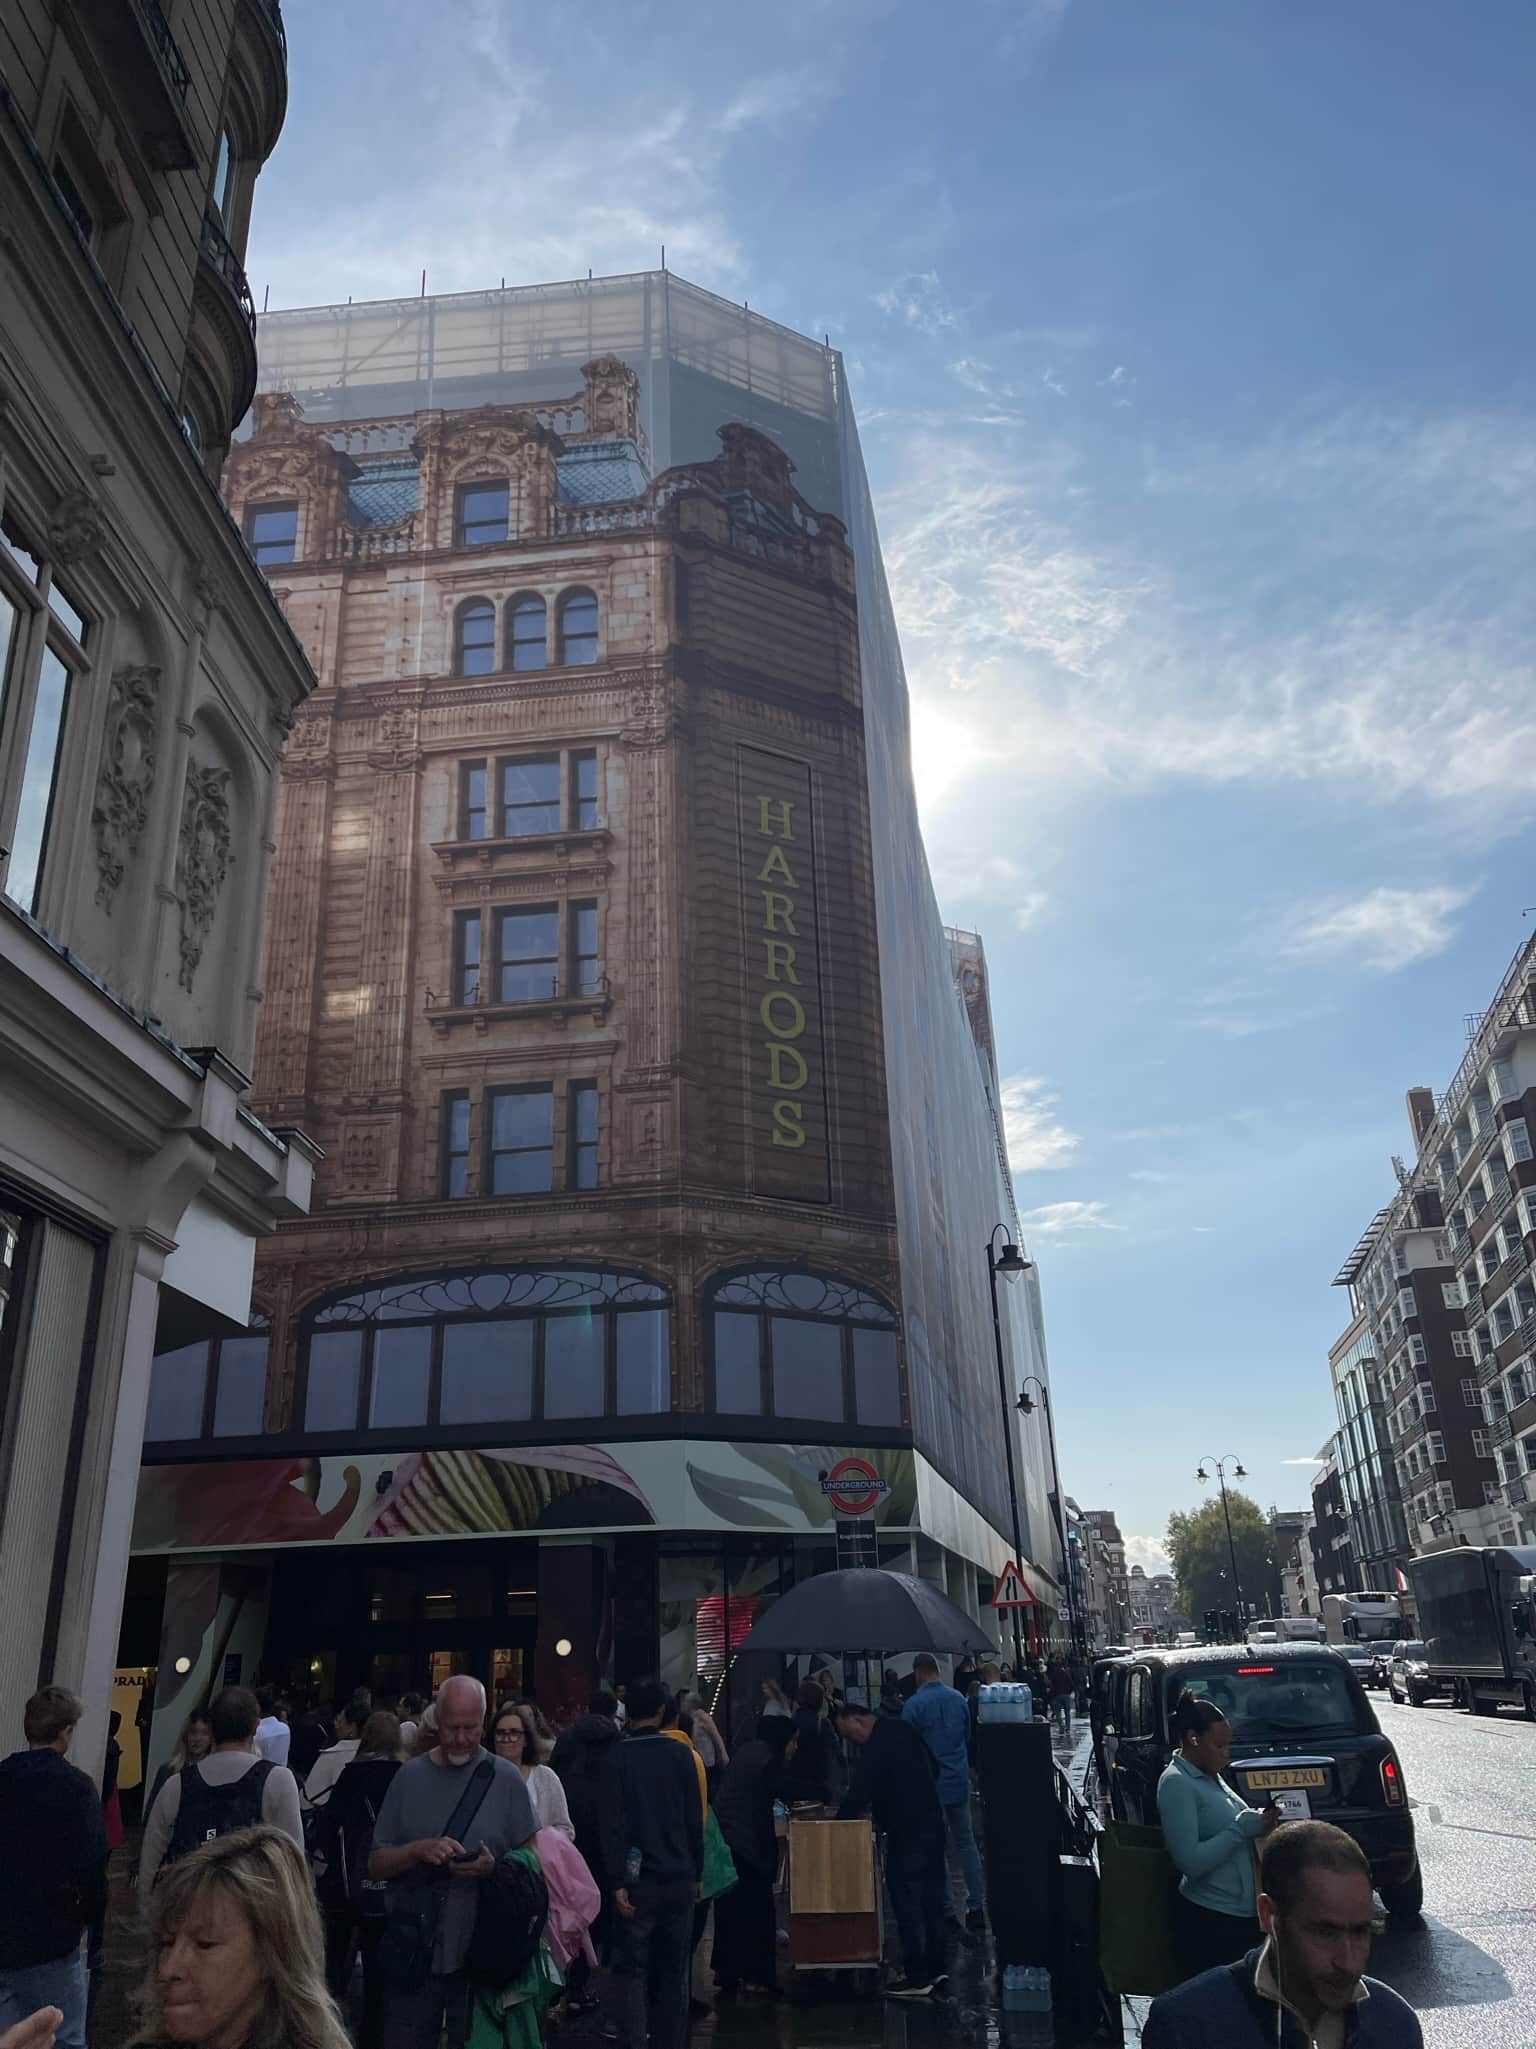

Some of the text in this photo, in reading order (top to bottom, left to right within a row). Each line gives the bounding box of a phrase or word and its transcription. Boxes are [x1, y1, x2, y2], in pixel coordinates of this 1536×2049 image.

[757, 796, 808, 1148] HARRODS
[823, 1480, 885, 1489] UNDERGROUND
[1252, 1770, 1319, 1786] LN73 ZXU
